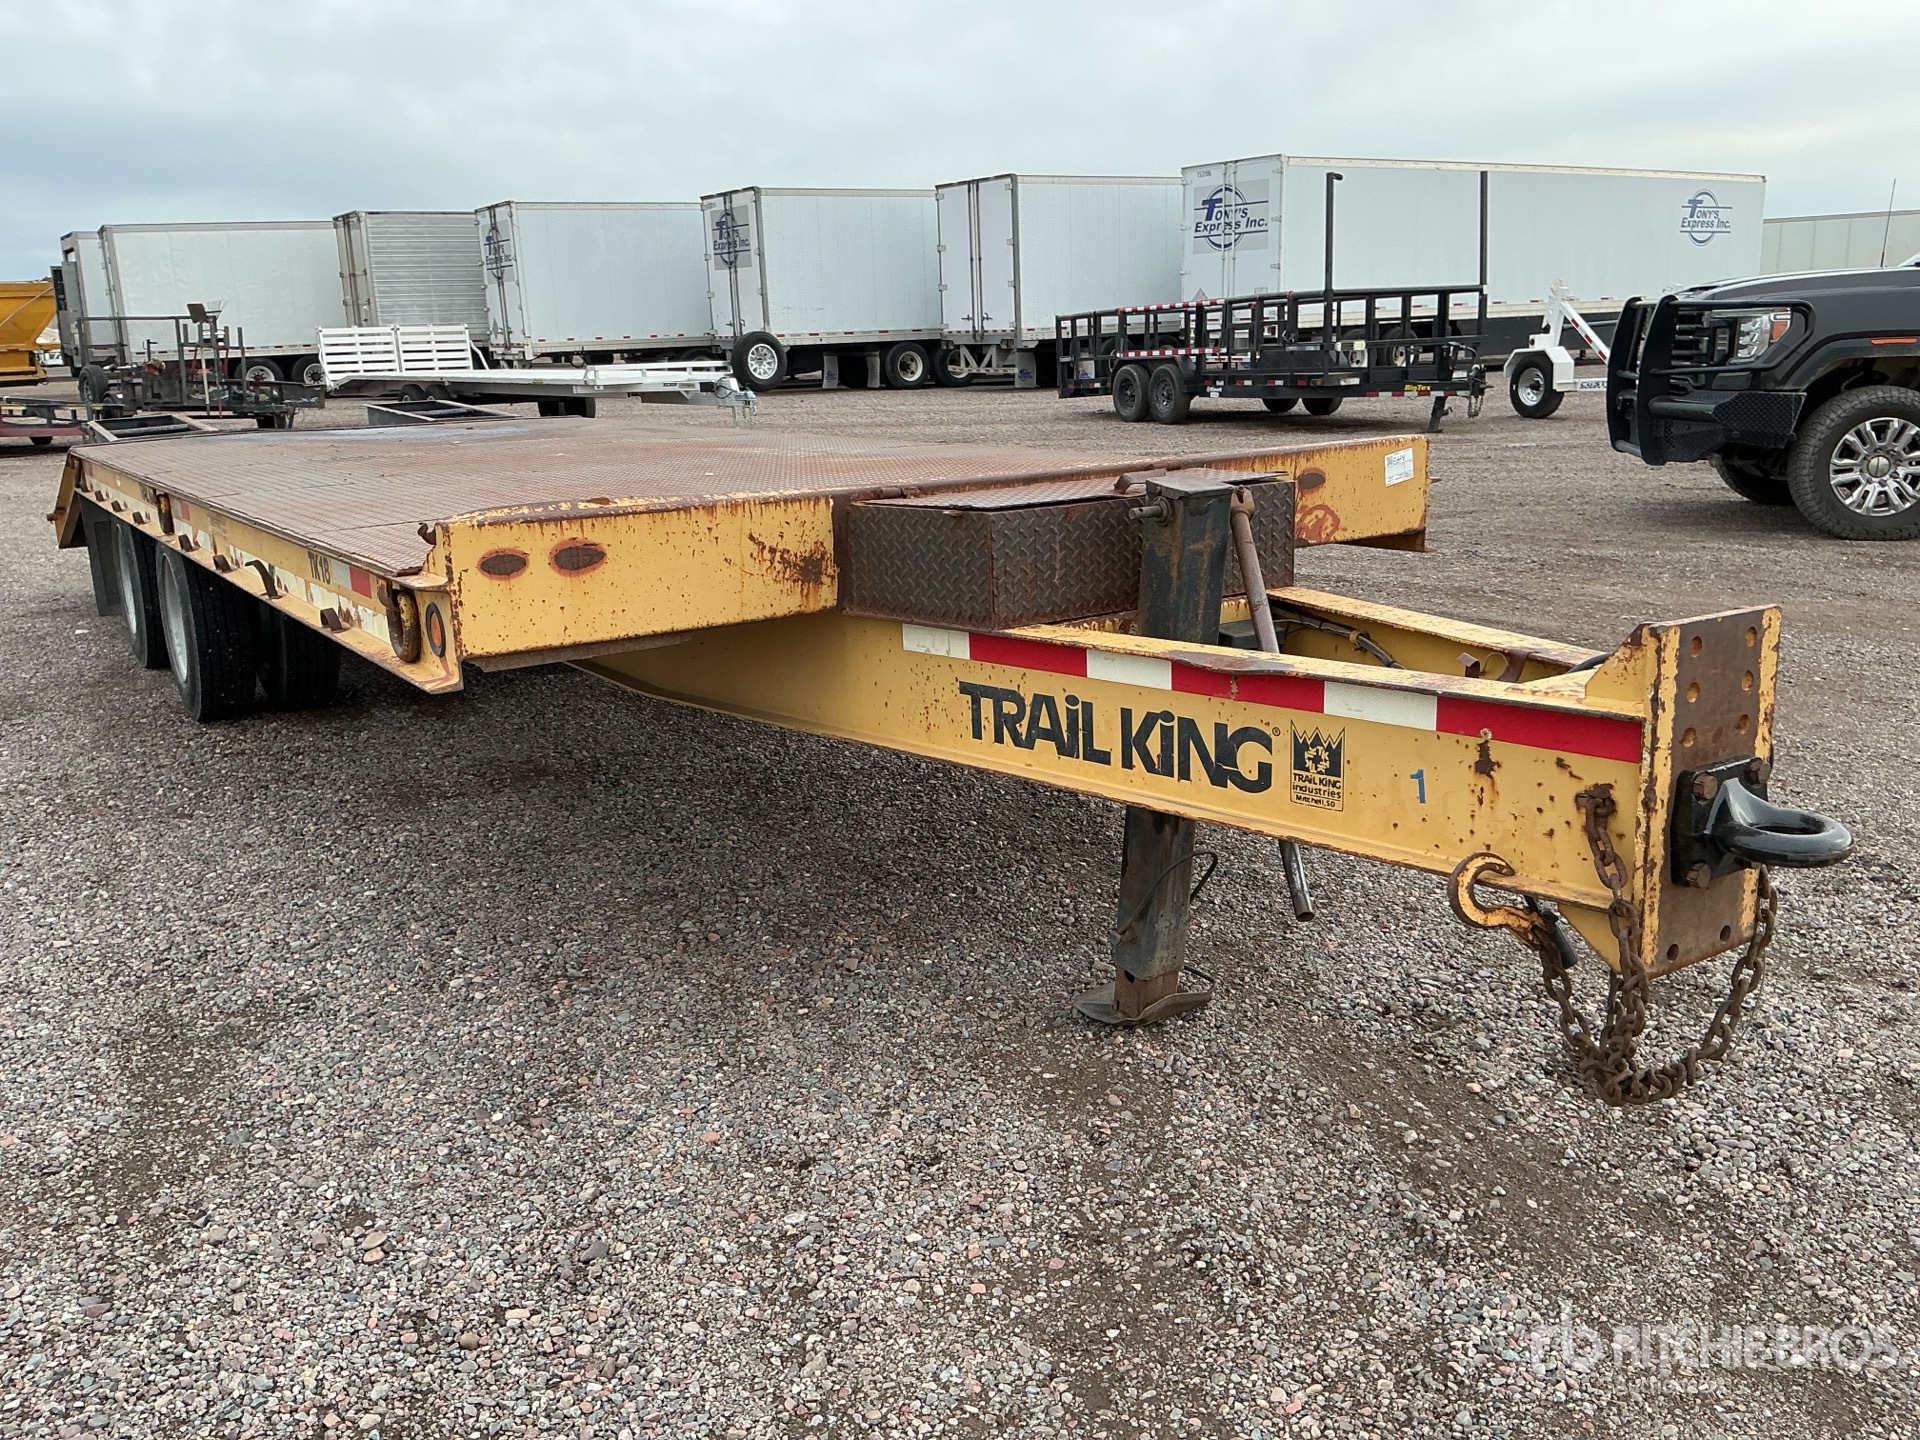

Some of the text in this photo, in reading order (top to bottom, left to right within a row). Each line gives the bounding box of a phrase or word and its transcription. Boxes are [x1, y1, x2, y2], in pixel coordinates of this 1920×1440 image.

[1194, 216, 1269, 234] Express Inc.
[1681, 217, 1715, 230] Express
[1292, 782, 1341, 799] industries
[1410, 768, 1426, 804] 1
[1326, 799, 1336, 808] SD
